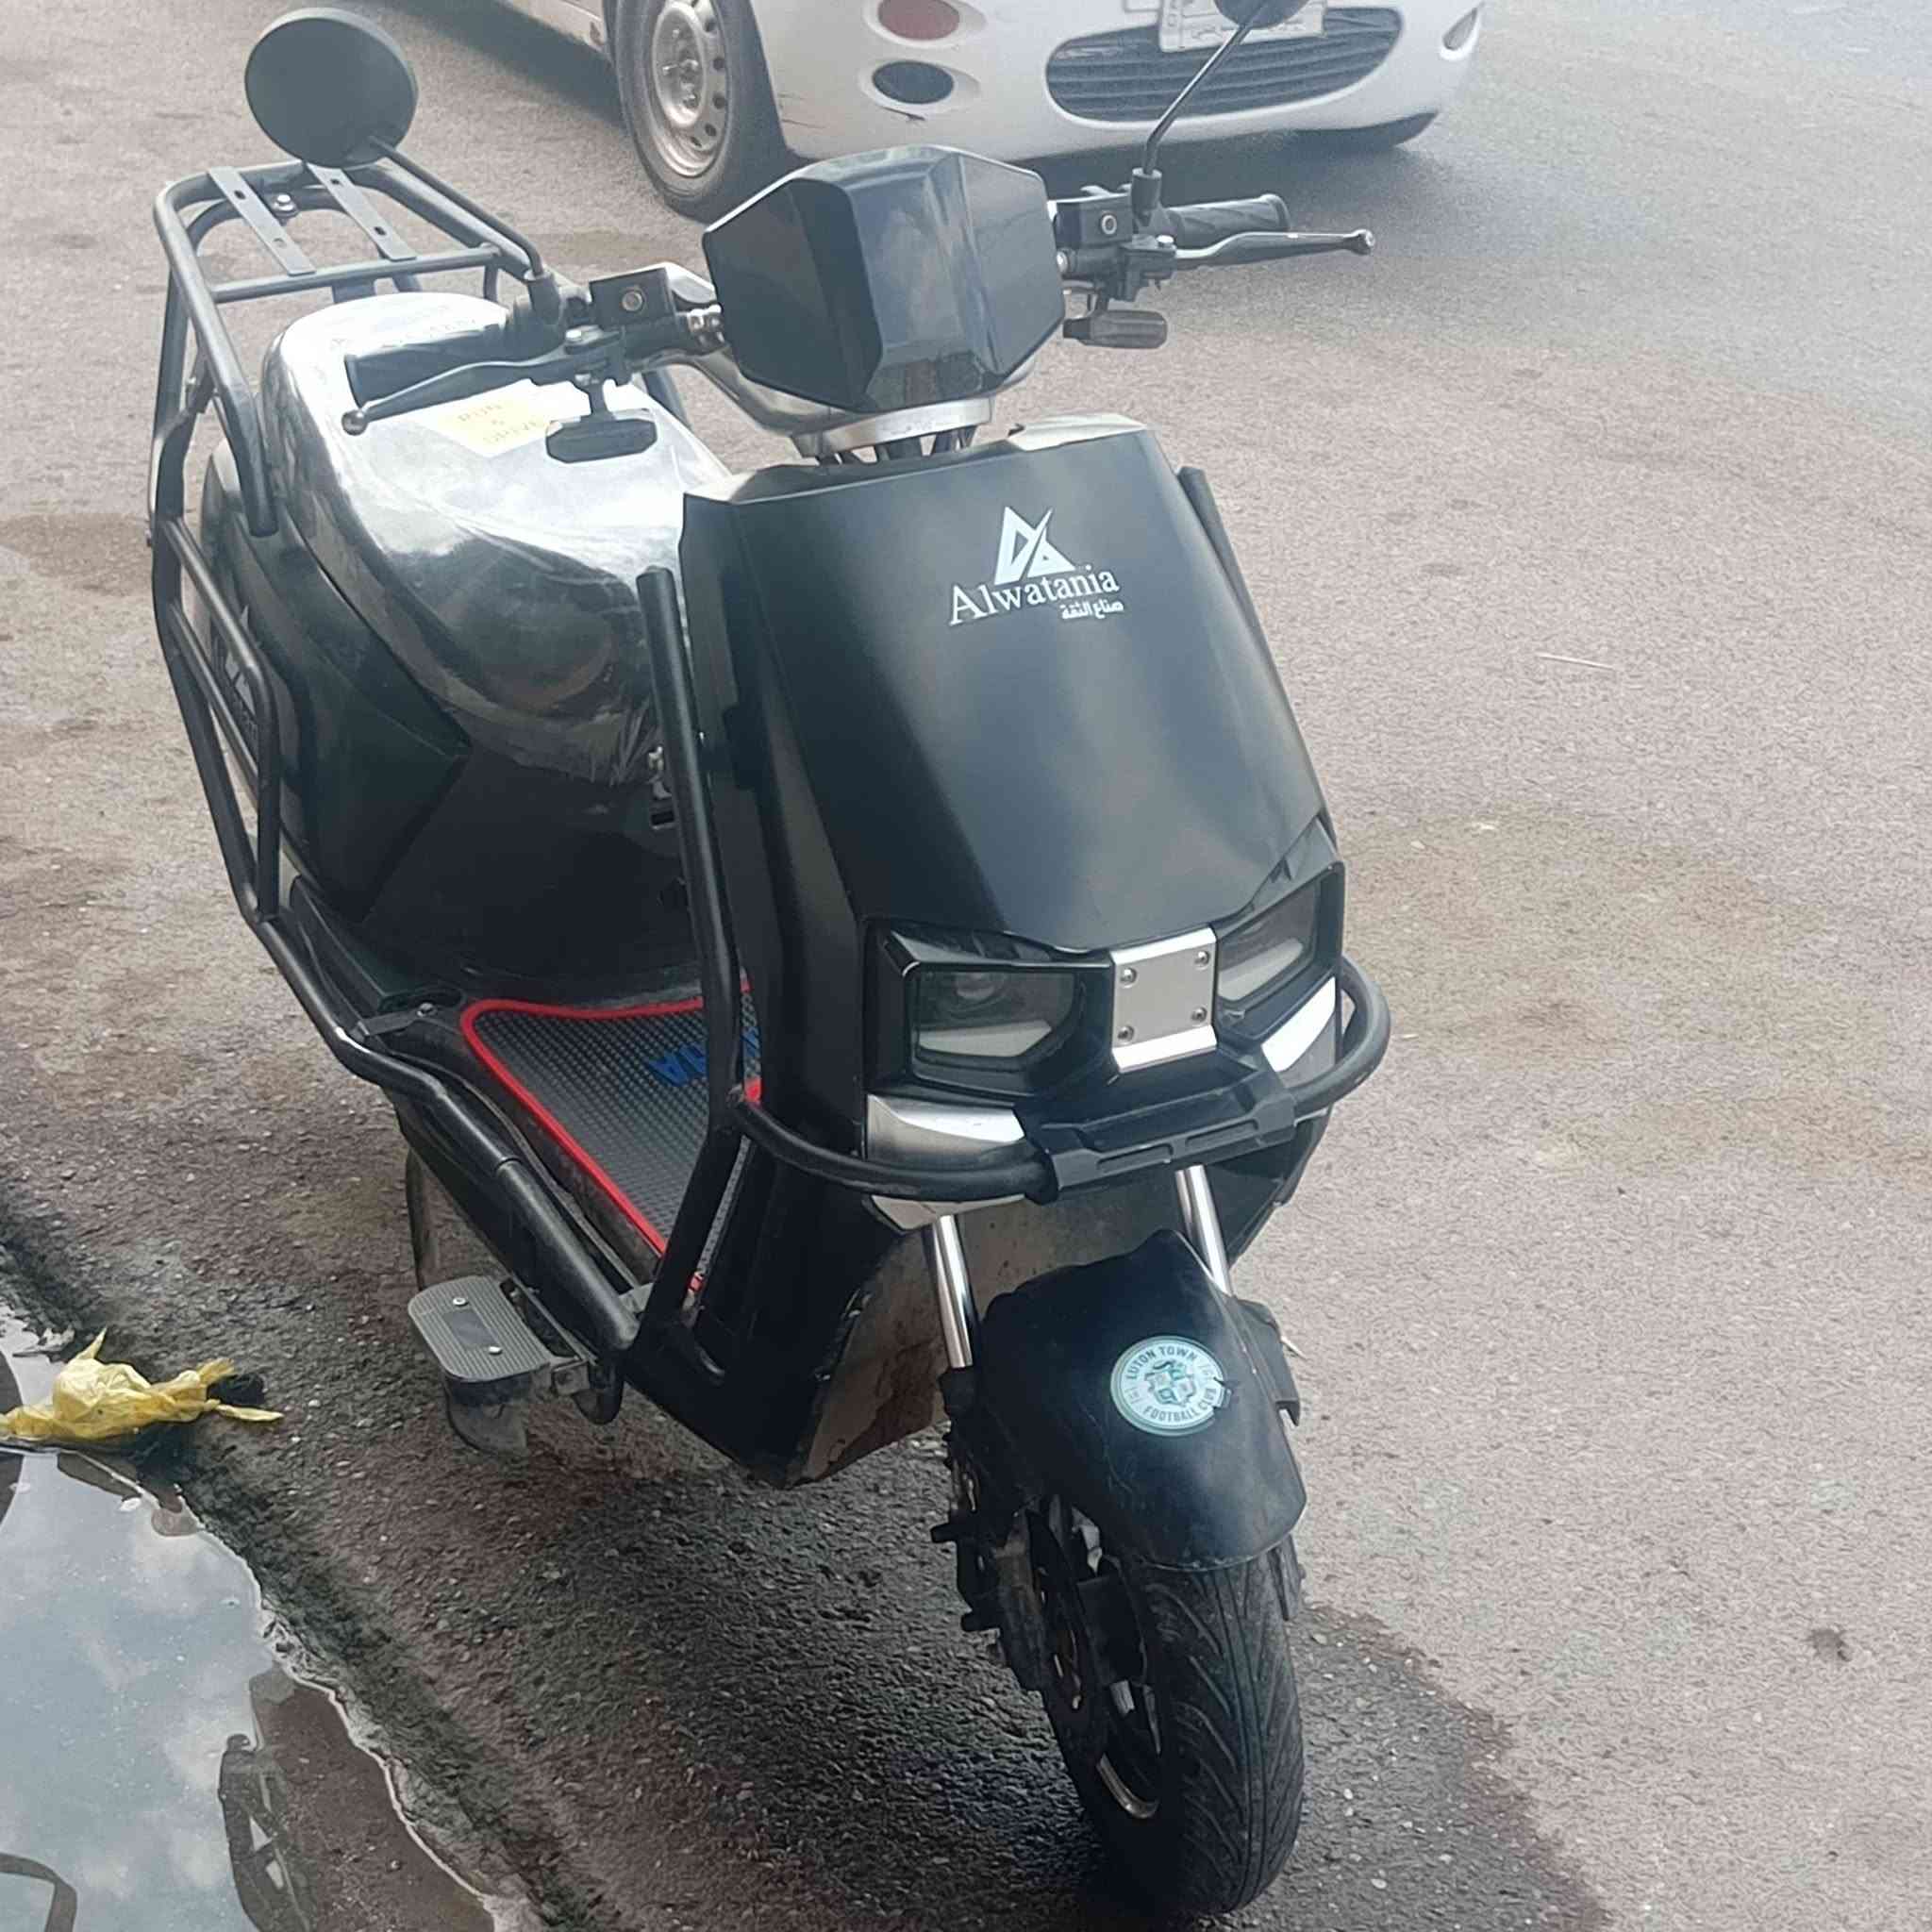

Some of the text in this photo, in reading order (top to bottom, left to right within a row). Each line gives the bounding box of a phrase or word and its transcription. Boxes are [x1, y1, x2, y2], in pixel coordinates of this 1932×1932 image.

[950, 564, 1120, 626] Alwatania
[1059, 599, 1124, 619] صناع الثقة
[1126, 1346, 1198, 1379] LUTON TOWN
[1141, 1404, 1203, 1423] FOOTBALL
